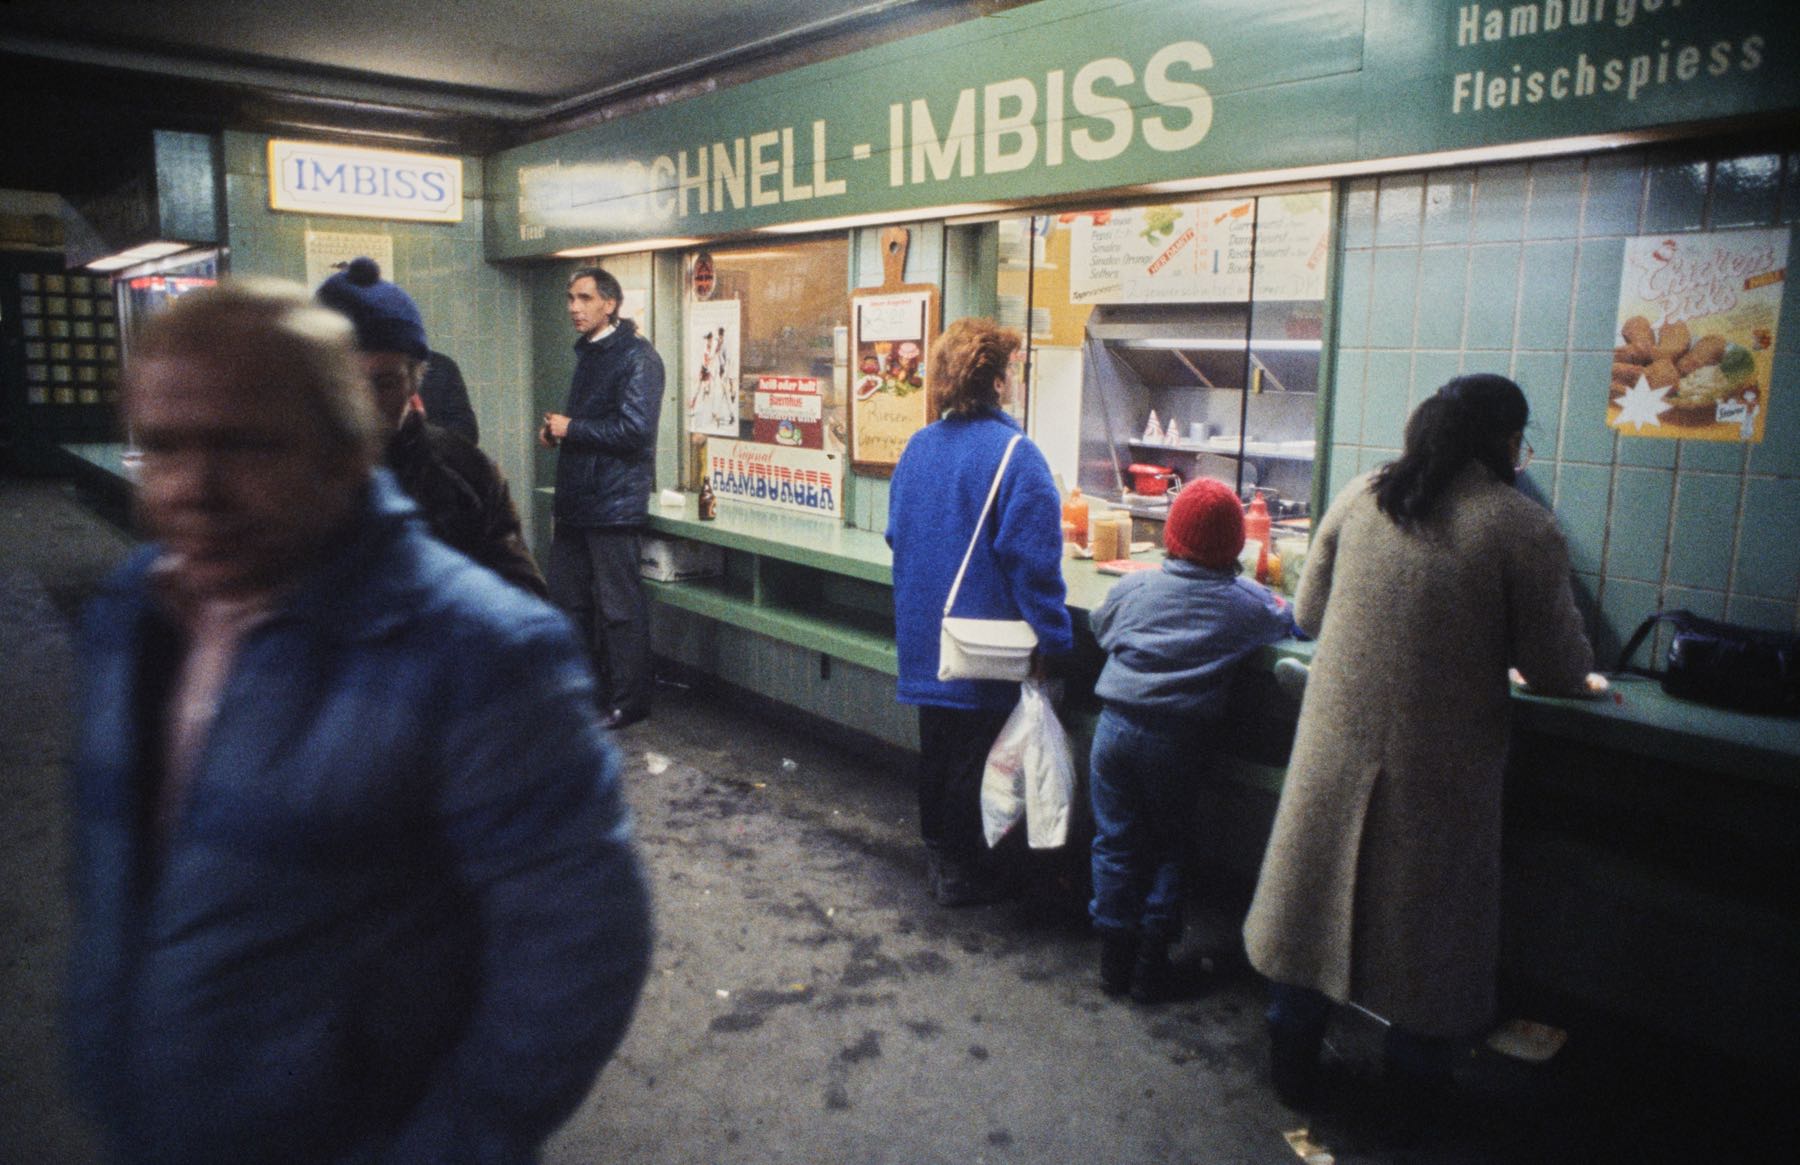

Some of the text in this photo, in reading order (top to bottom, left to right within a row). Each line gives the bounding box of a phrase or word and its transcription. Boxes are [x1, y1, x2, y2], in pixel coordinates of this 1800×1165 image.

[1458, 0, 1682, 47] Hamburg
[1452, 35, 1766, 114] Fleischspiess
[889, 40, 1214, 188] IMBISS
[294, 157, 447, 203] IMBISS
[732, 441, 776, 465] Original
[712, 456, 834, 511] HAMBURGER
